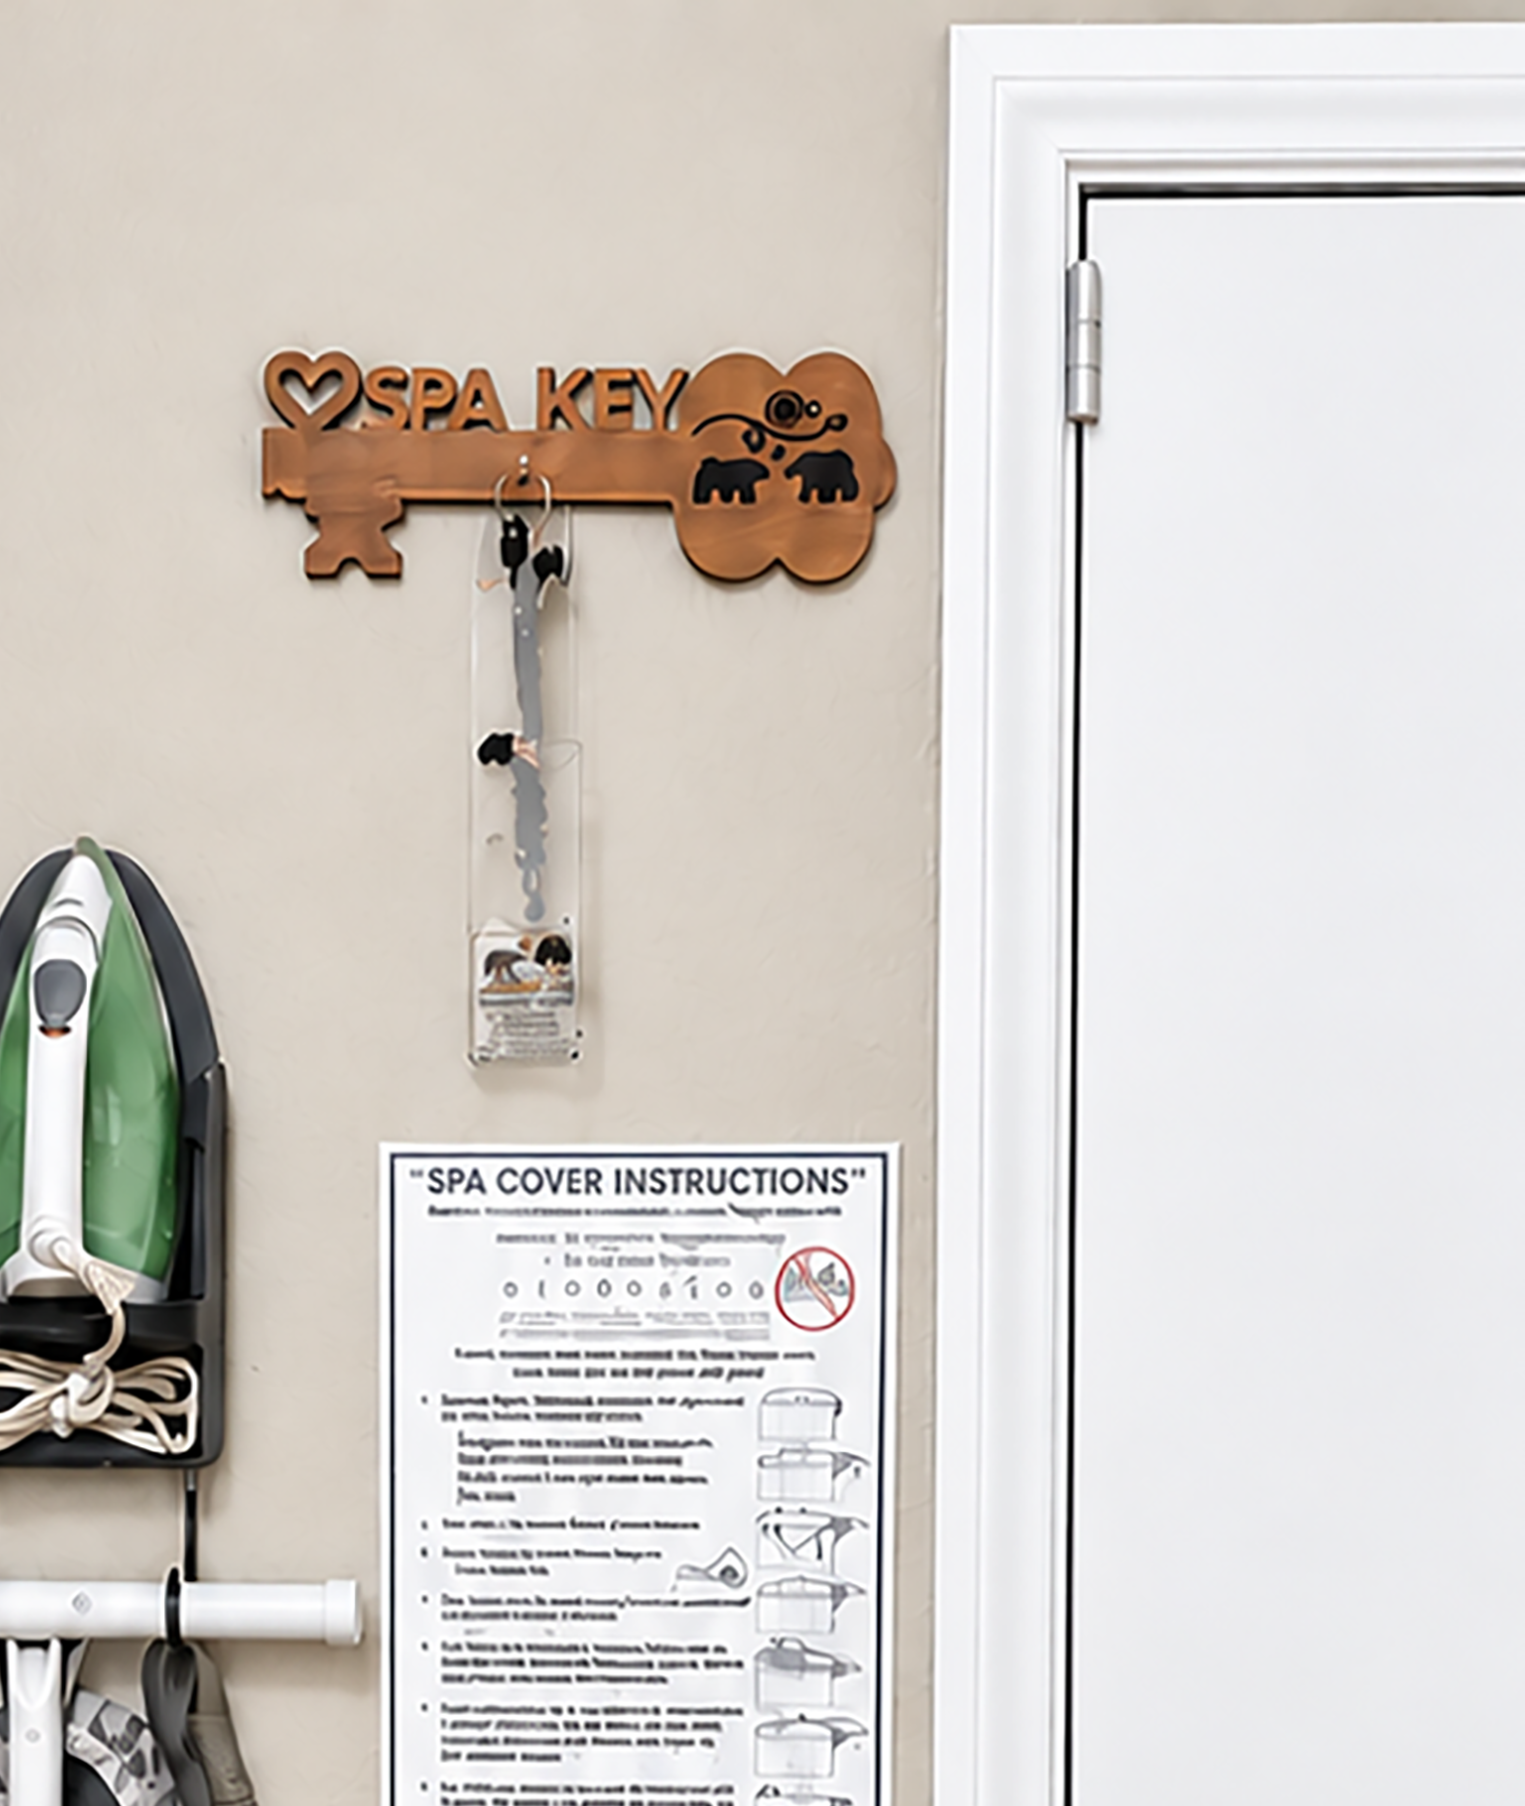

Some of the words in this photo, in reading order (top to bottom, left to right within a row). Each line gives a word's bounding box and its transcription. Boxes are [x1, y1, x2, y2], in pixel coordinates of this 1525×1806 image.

[365, 366, 508, 431] SPA
[536, 366, 689, 431] KEY
[496, 1167, 603, 1195] COVER
